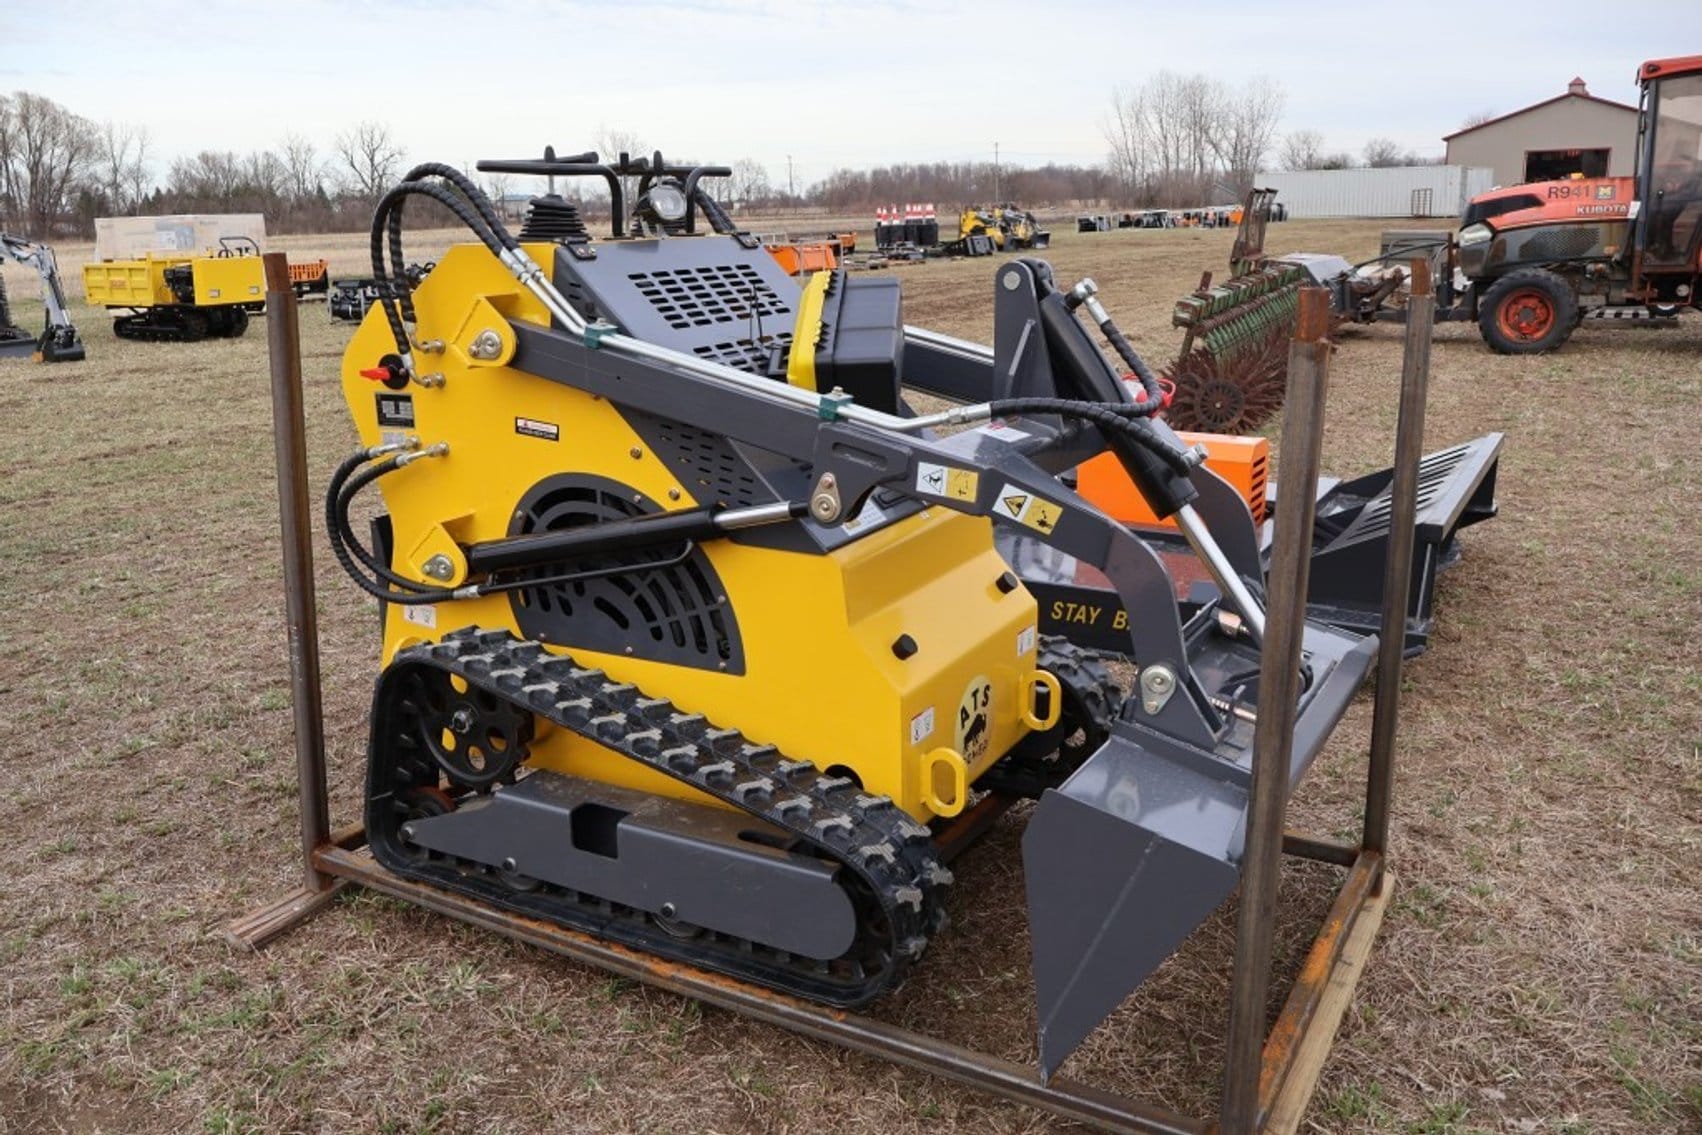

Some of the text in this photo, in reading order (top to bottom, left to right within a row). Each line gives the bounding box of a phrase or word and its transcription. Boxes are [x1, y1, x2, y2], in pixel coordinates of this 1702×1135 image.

[1547, 185, 1590, 199] R941
[1576, 204, 1627, 215] KUBOTA
[1051, 601, 1131, 631] STAY B
